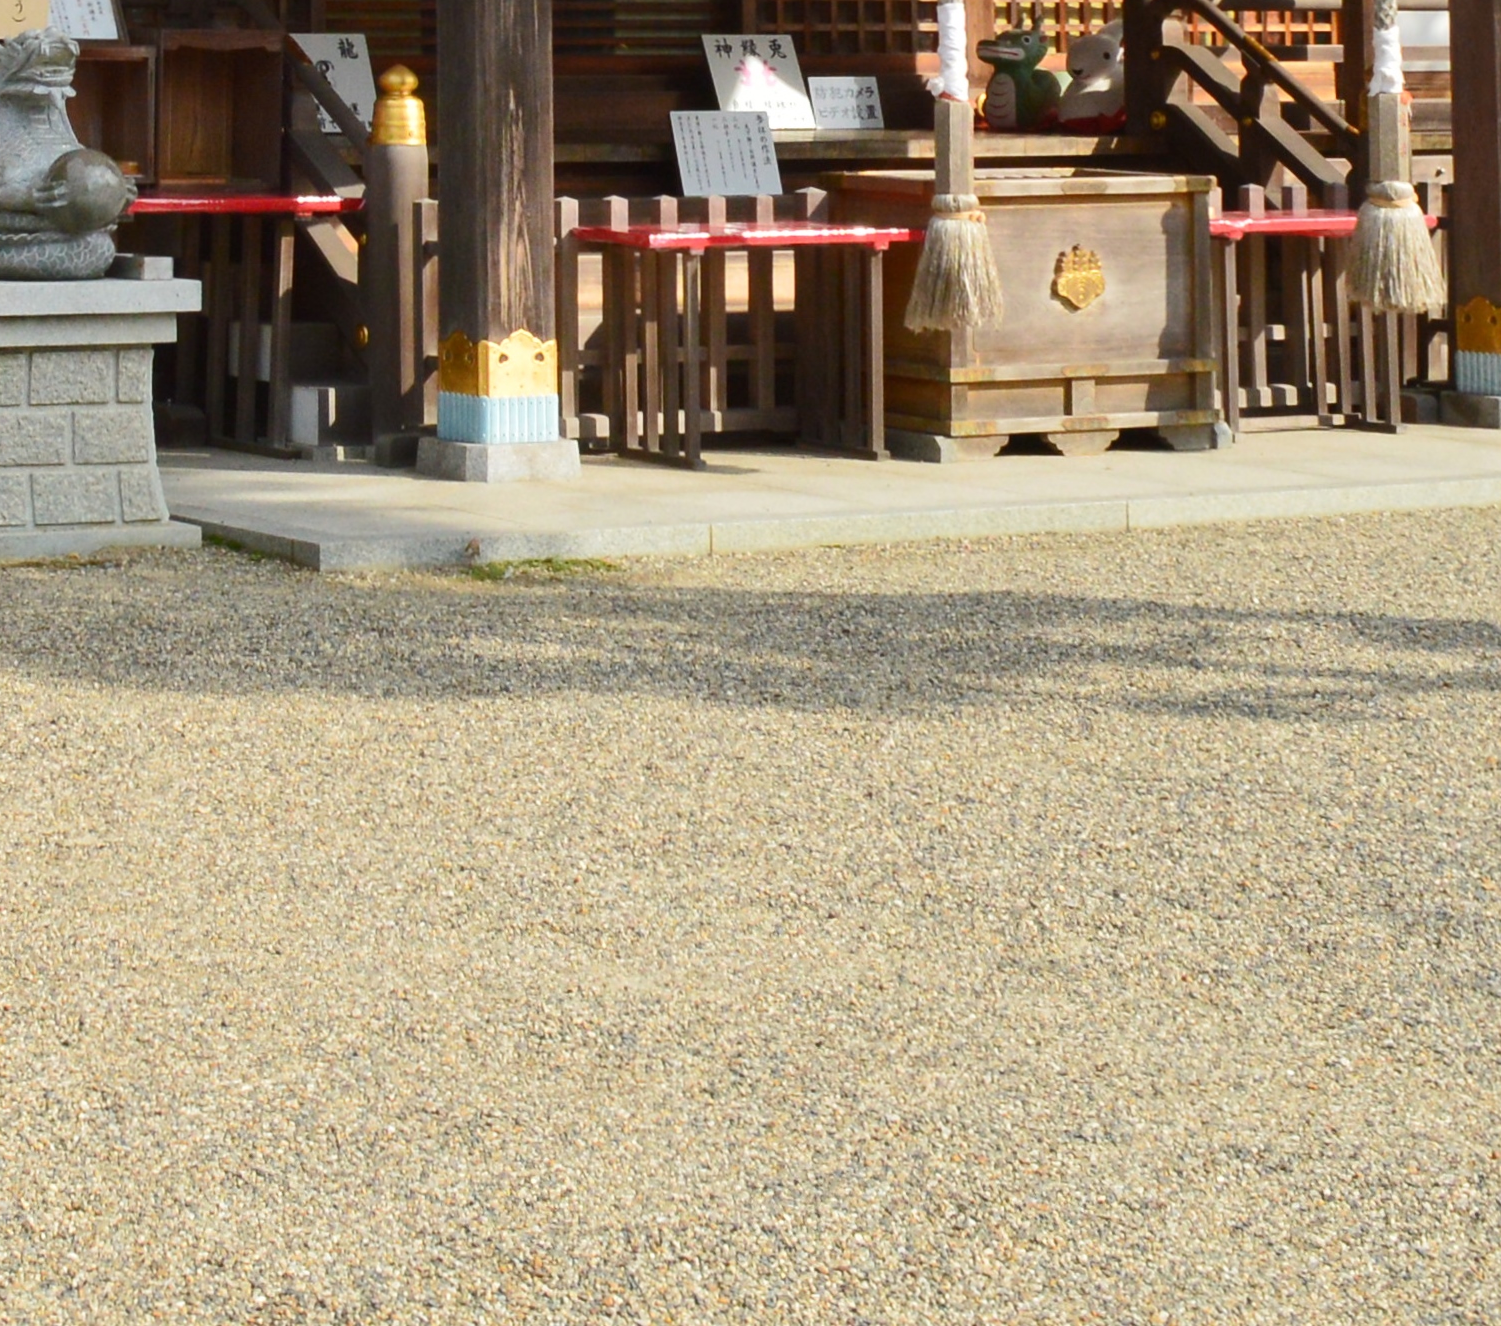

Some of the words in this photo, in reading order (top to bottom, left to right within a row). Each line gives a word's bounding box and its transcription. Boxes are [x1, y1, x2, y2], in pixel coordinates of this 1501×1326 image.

[714, 37, 787, 60] 神縁兎
[814, 84, 875, 100] 防犯カメラ
[819, 103, 879, 121] ビデオ設置
